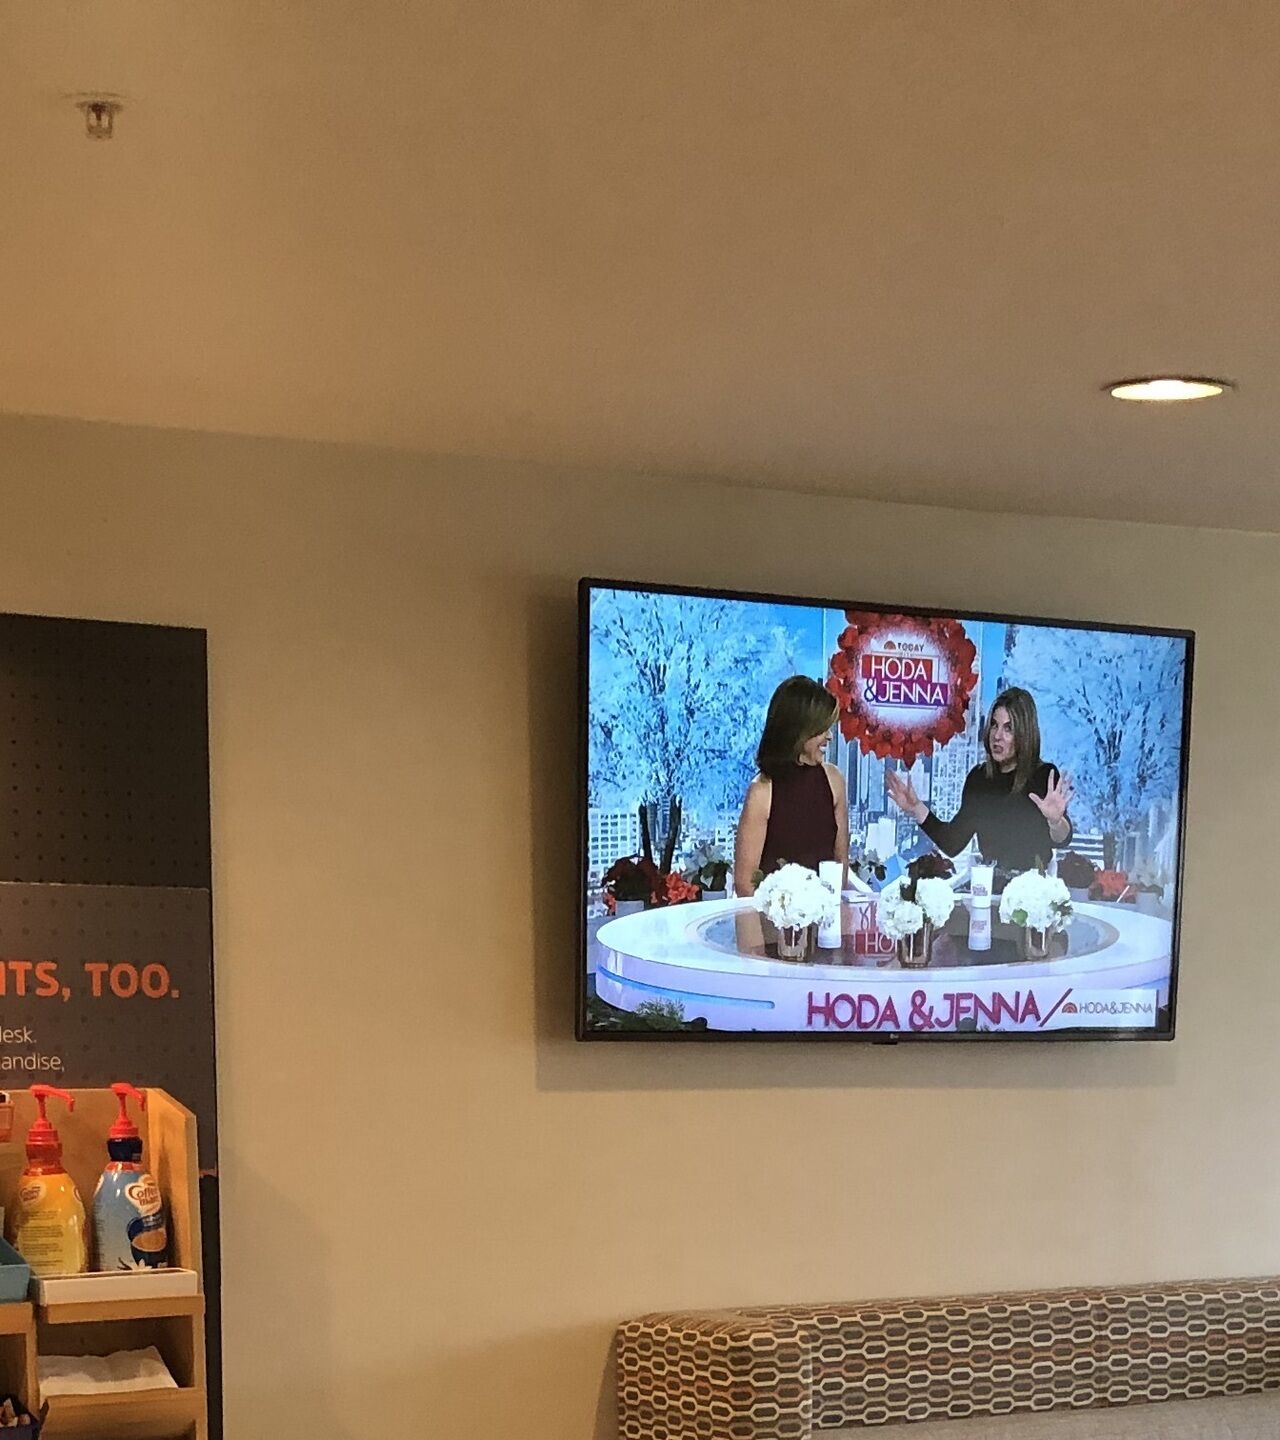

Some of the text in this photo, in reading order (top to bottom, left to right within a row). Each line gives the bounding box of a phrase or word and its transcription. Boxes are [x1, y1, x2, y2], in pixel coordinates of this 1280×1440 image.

[897, 642, 925, 652] TODAY
[871, 656, 927, 680] HODA
[863, 678, 945, 704] &JENNA
[84, 962, 179, 998] TOO.
[807, 990, 901, 1030] HODA
[1078, 1000, 1153, 1015] HODA&JENNA
